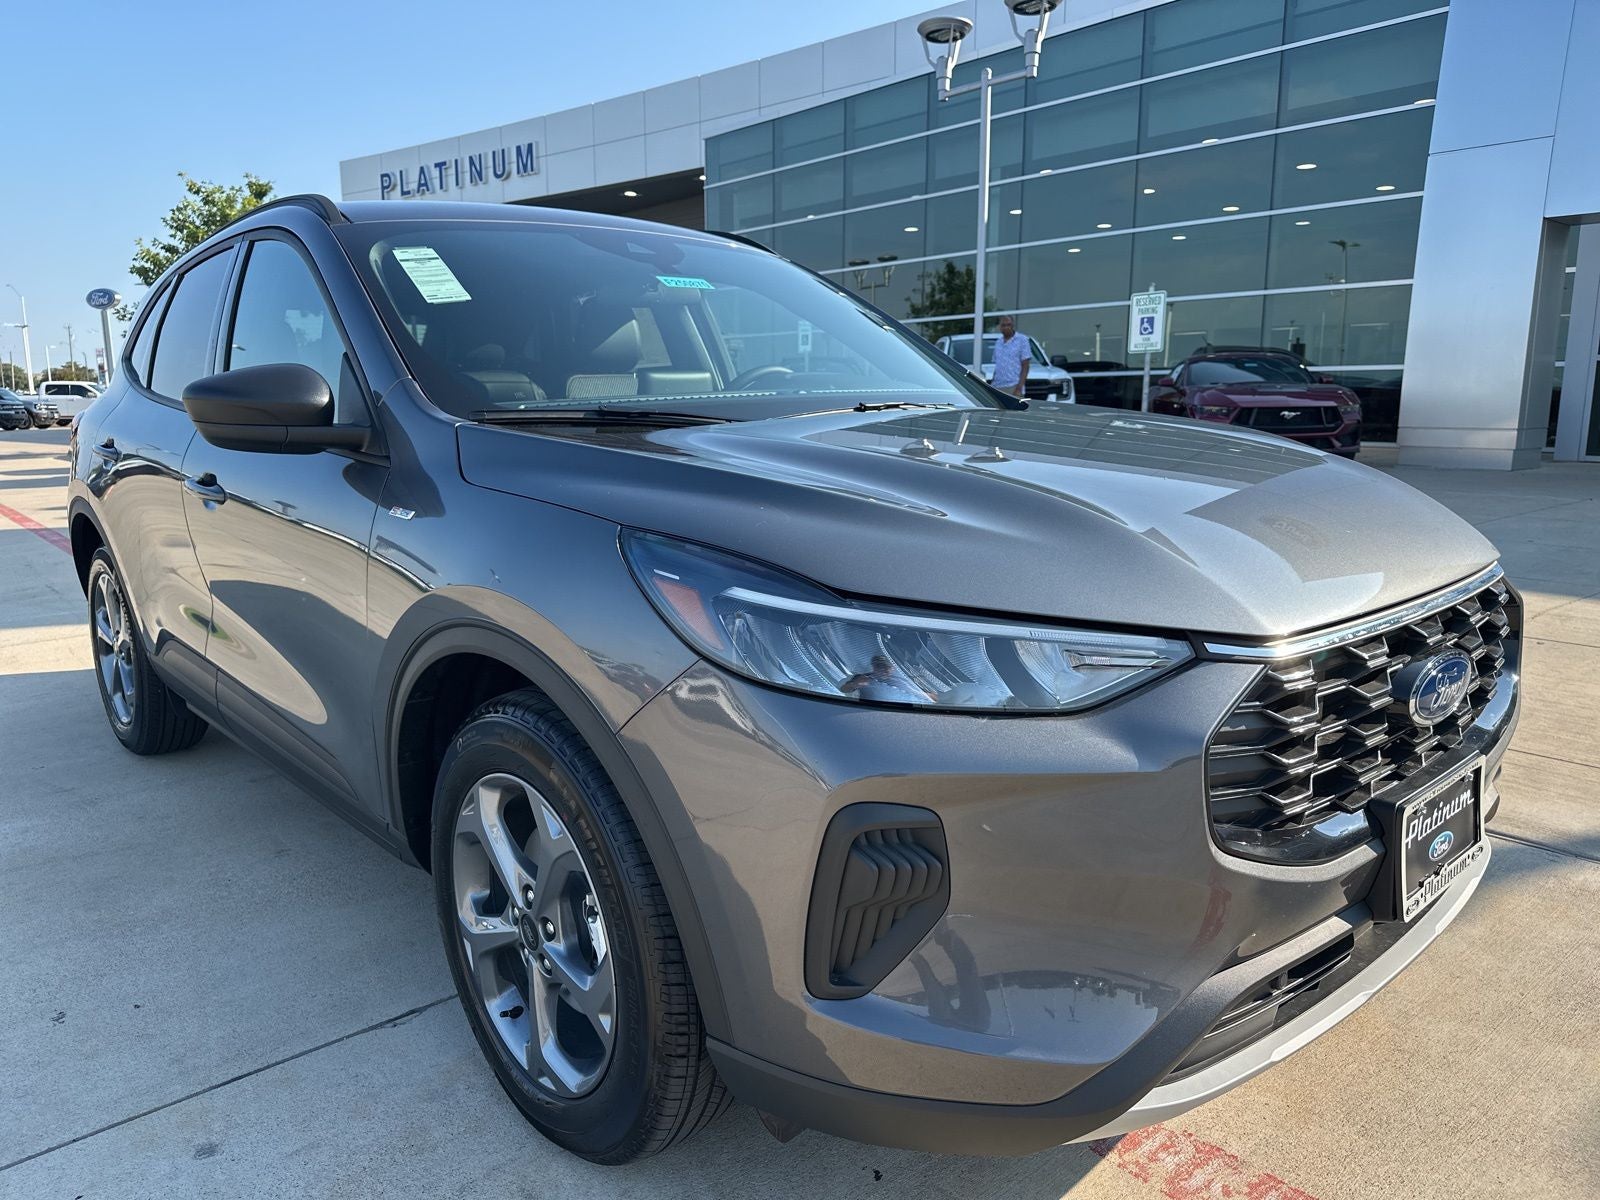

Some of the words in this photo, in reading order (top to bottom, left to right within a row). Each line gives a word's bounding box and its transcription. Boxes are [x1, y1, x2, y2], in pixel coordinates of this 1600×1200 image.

[380, 142, 536, 200] PLATINUM
[91, 292, 109, 305] Ford
[1135, 295, 1162, 307] RESERVED
[1138, 306, 1158, 315] PARKING
[1431, 667, 1466, 711] Ford
[1405, 789, 1475, 849] Platinum
[1423, 858, 1471, 903] Platinum
